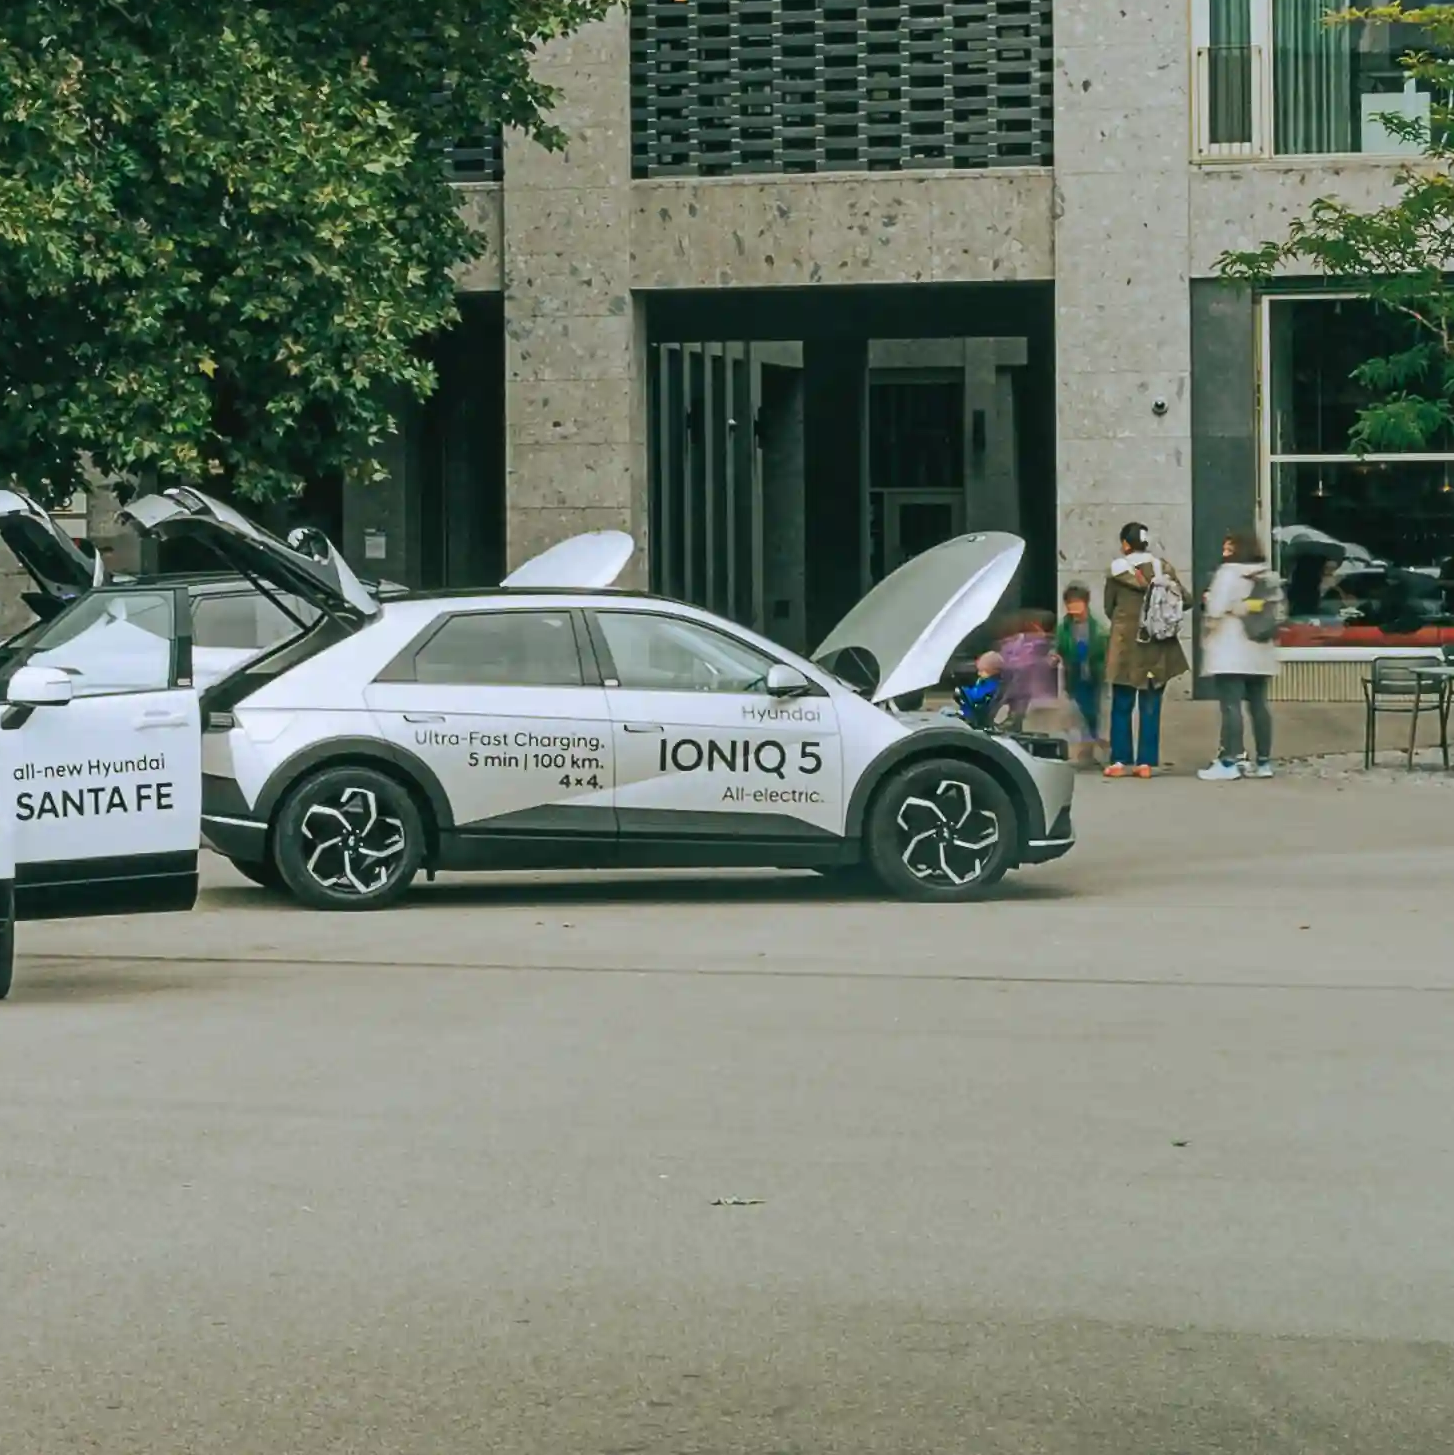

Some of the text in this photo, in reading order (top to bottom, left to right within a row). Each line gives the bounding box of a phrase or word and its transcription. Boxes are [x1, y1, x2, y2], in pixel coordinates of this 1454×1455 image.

[742, 705, 821, 722] Hyundai
[414, 729, 606, 751] Ultra-Fast Charging.
[13, 752, 166, 781] all-new Hyundai
[468, 752, 479, 767] 5
[484, 751, 519, 768] min
[532, 753, 566, 768] 100
[570, 753, 605, 769] km.
[659, 738, 822, 780] IONIQ 5
[15, 782, 174, 822] SANTA FE
[721, 786, 825, 803] All-electric.
